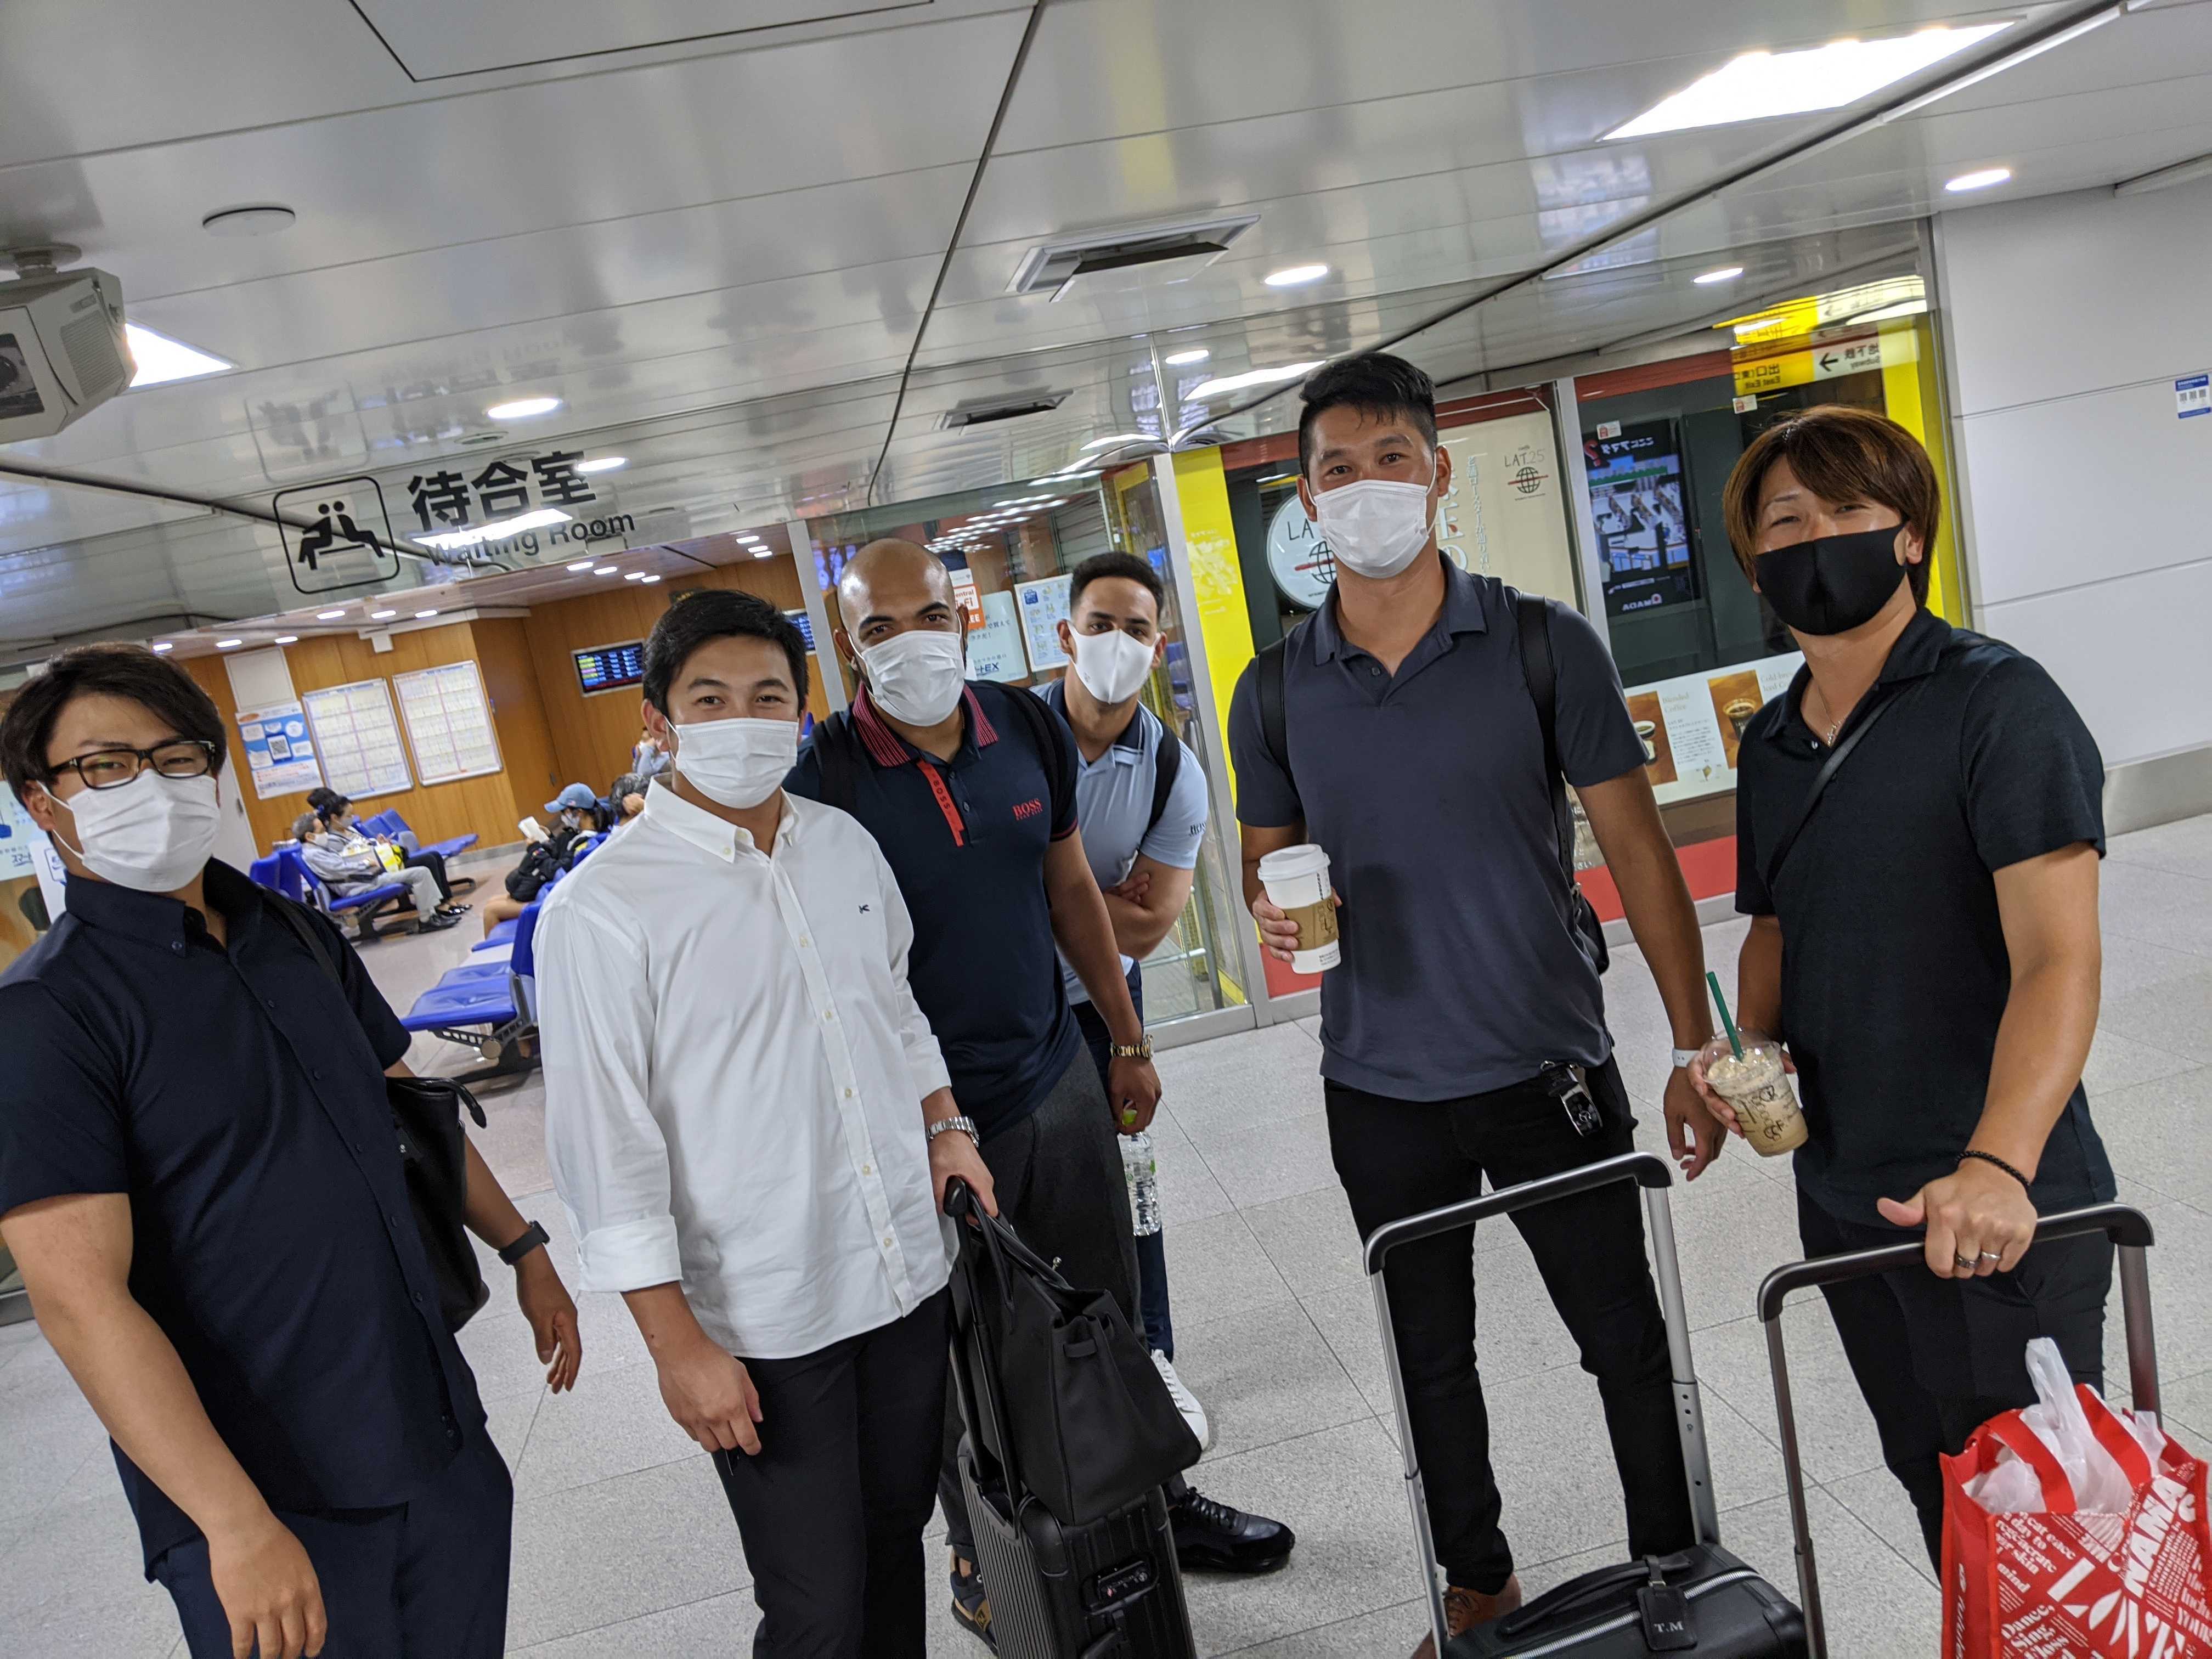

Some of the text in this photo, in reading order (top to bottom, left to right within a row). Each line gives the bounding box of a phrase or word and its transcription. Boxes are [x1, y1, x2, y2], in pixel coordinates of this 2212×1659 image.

[408, 450, 597, 532] 待合室
[550, 513, 635, 545] Room
[955, 589, 974, 600] entral
[932, 778, 951, 811] BOSS
[1012, 798, 1042, 817] BOSS
[2013, 1549, 2040, 1576] skin
